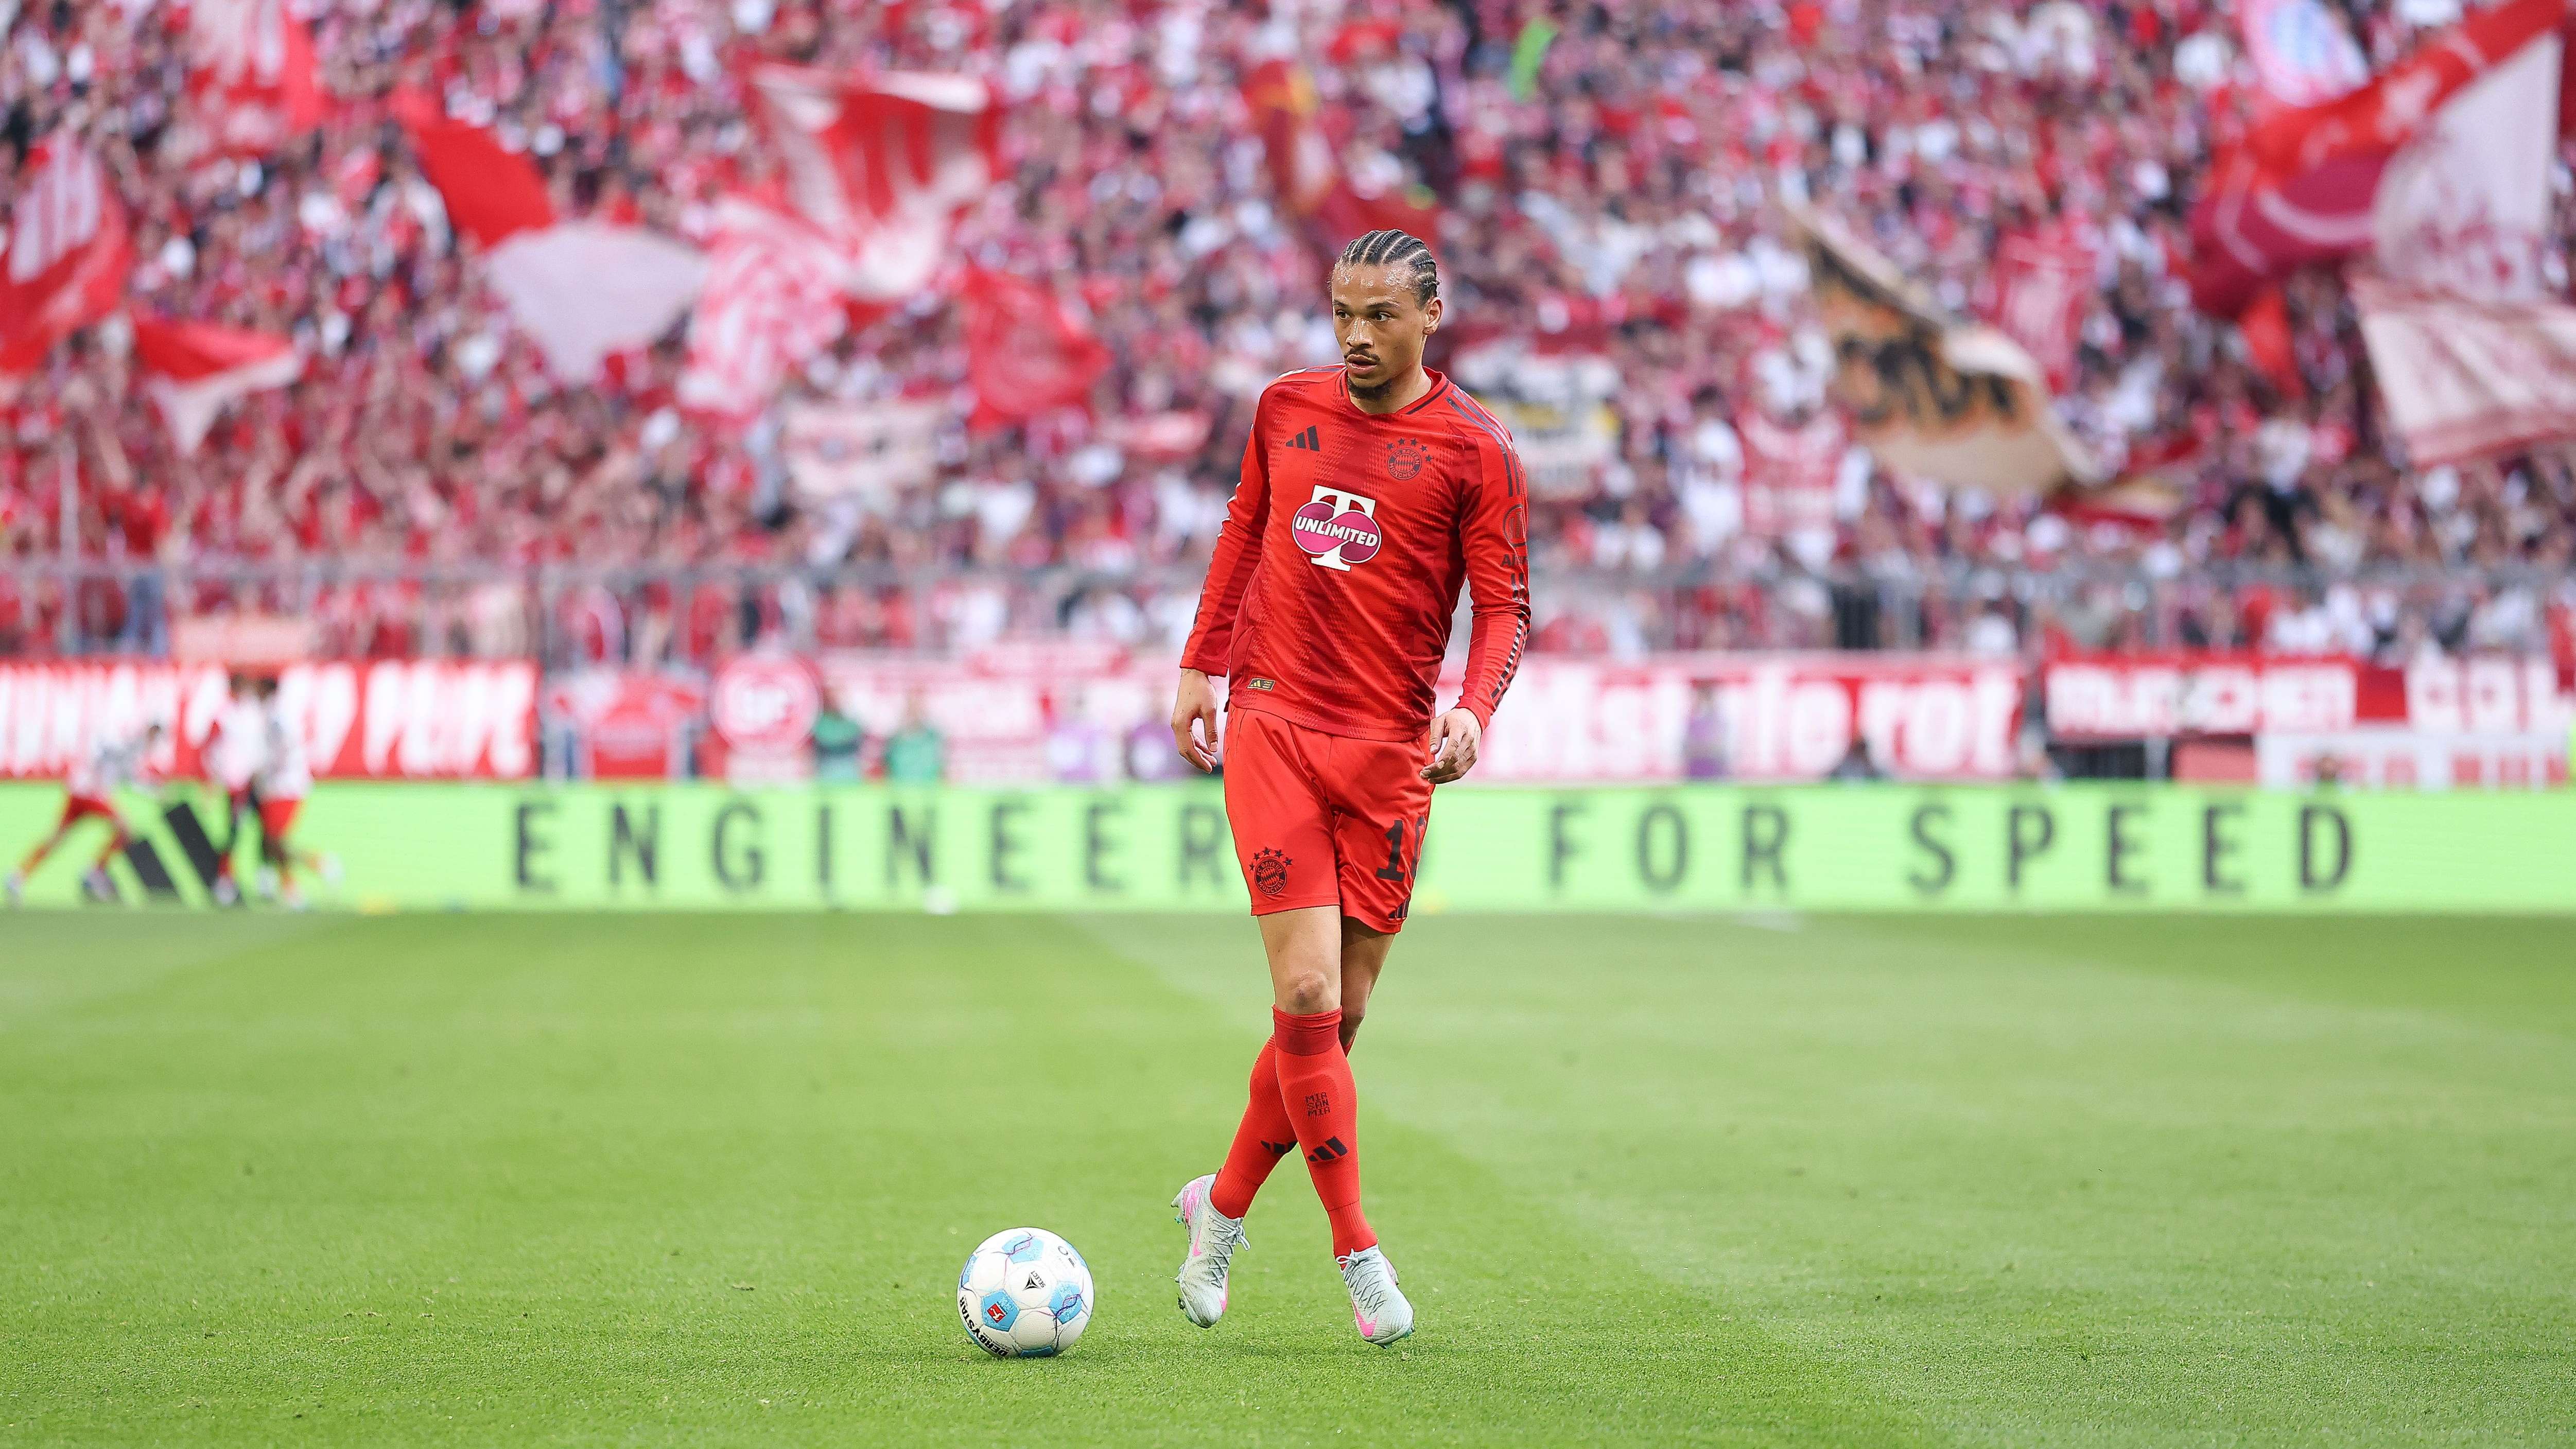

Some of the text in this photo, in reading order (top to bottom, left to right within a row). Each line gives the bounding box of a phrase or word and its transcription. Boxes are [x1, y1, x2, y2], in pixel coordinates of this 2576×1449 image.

[1295, 516, 1379, 547] UNLIMITED
[515, 801, 2357, 893] ENGINEER FOR SPEED
[1262, 861, 1283, 874] BAYERN
[1304, 1092, 1327, 1103] MIA
[1307, 1098, 1329, 1109] SAN
[1308, 1107, 1331, 1116] MIA
[1031, 1270, 1046, 1288] SELECT
[959, 1297, 1009, 1357] DERBYSTAR
